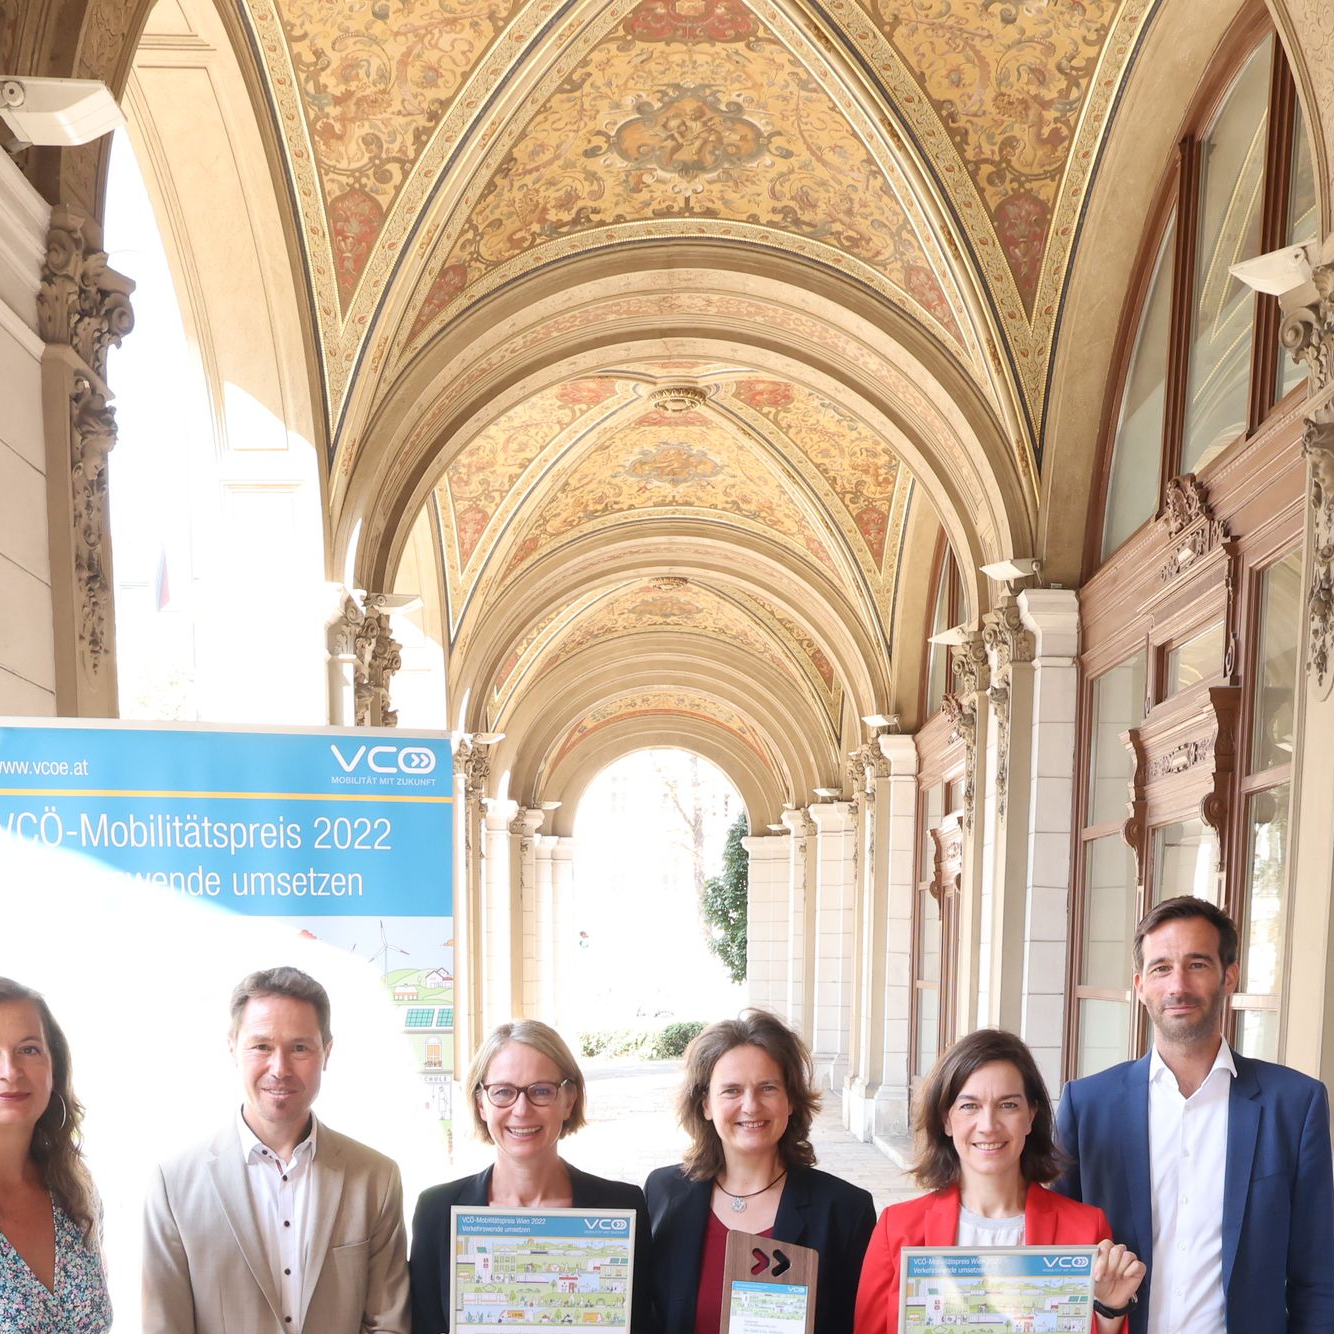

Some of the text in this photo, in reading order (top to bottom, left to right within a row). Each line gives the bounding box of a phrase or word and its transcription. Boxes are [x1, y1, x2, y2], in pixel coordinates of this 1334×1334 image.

[331, 775, 436, 786] MOBILITÄT MIT ZUKUNFT
[314, 817, 392, 850] 2022
[233, 867, 363, 896] umsetzen
[531, 1217, 547, 1225] 2022
